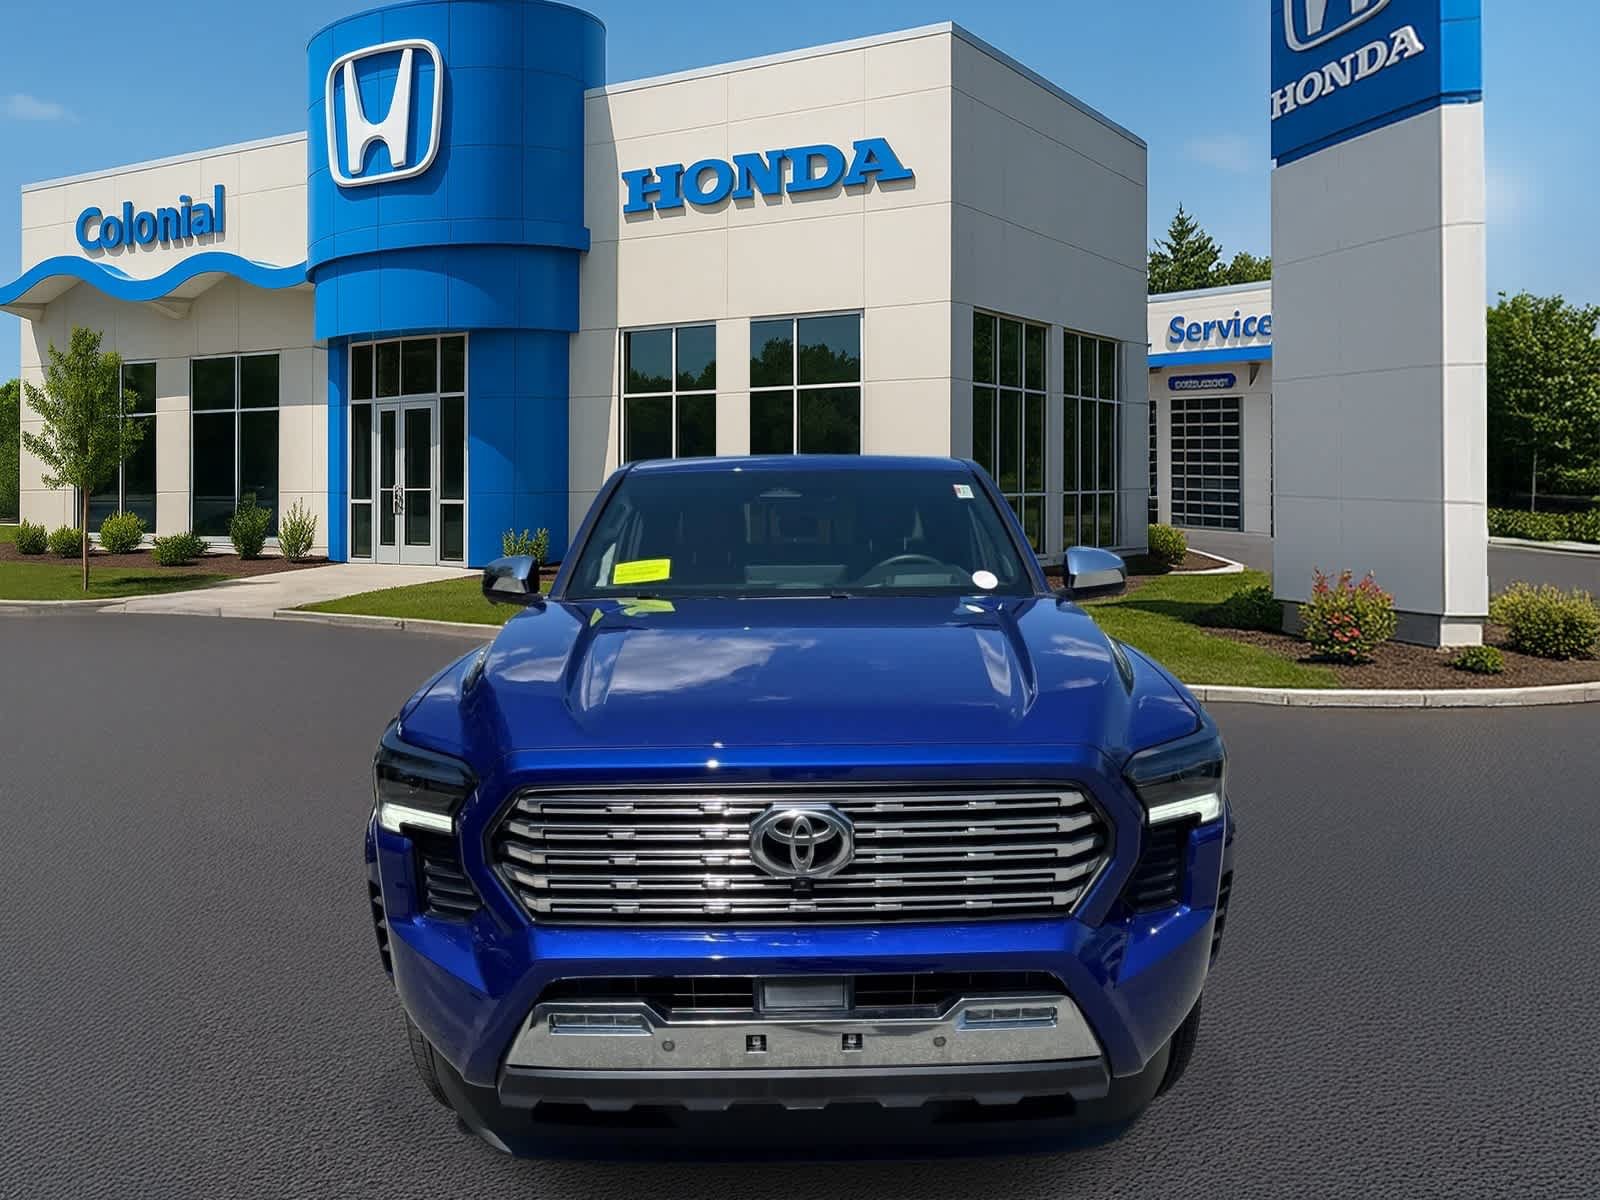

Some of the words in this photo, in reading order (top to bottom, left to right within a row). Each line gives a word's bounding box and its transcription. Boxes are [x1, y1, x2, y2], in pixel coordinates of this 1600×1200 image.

[1271, 25, 1425, 120] HONDA
[621, 137, 913, 214] HONDA
[75, 184, 225, 251] Colonial
[1169, 310, 1272, 344] Service
